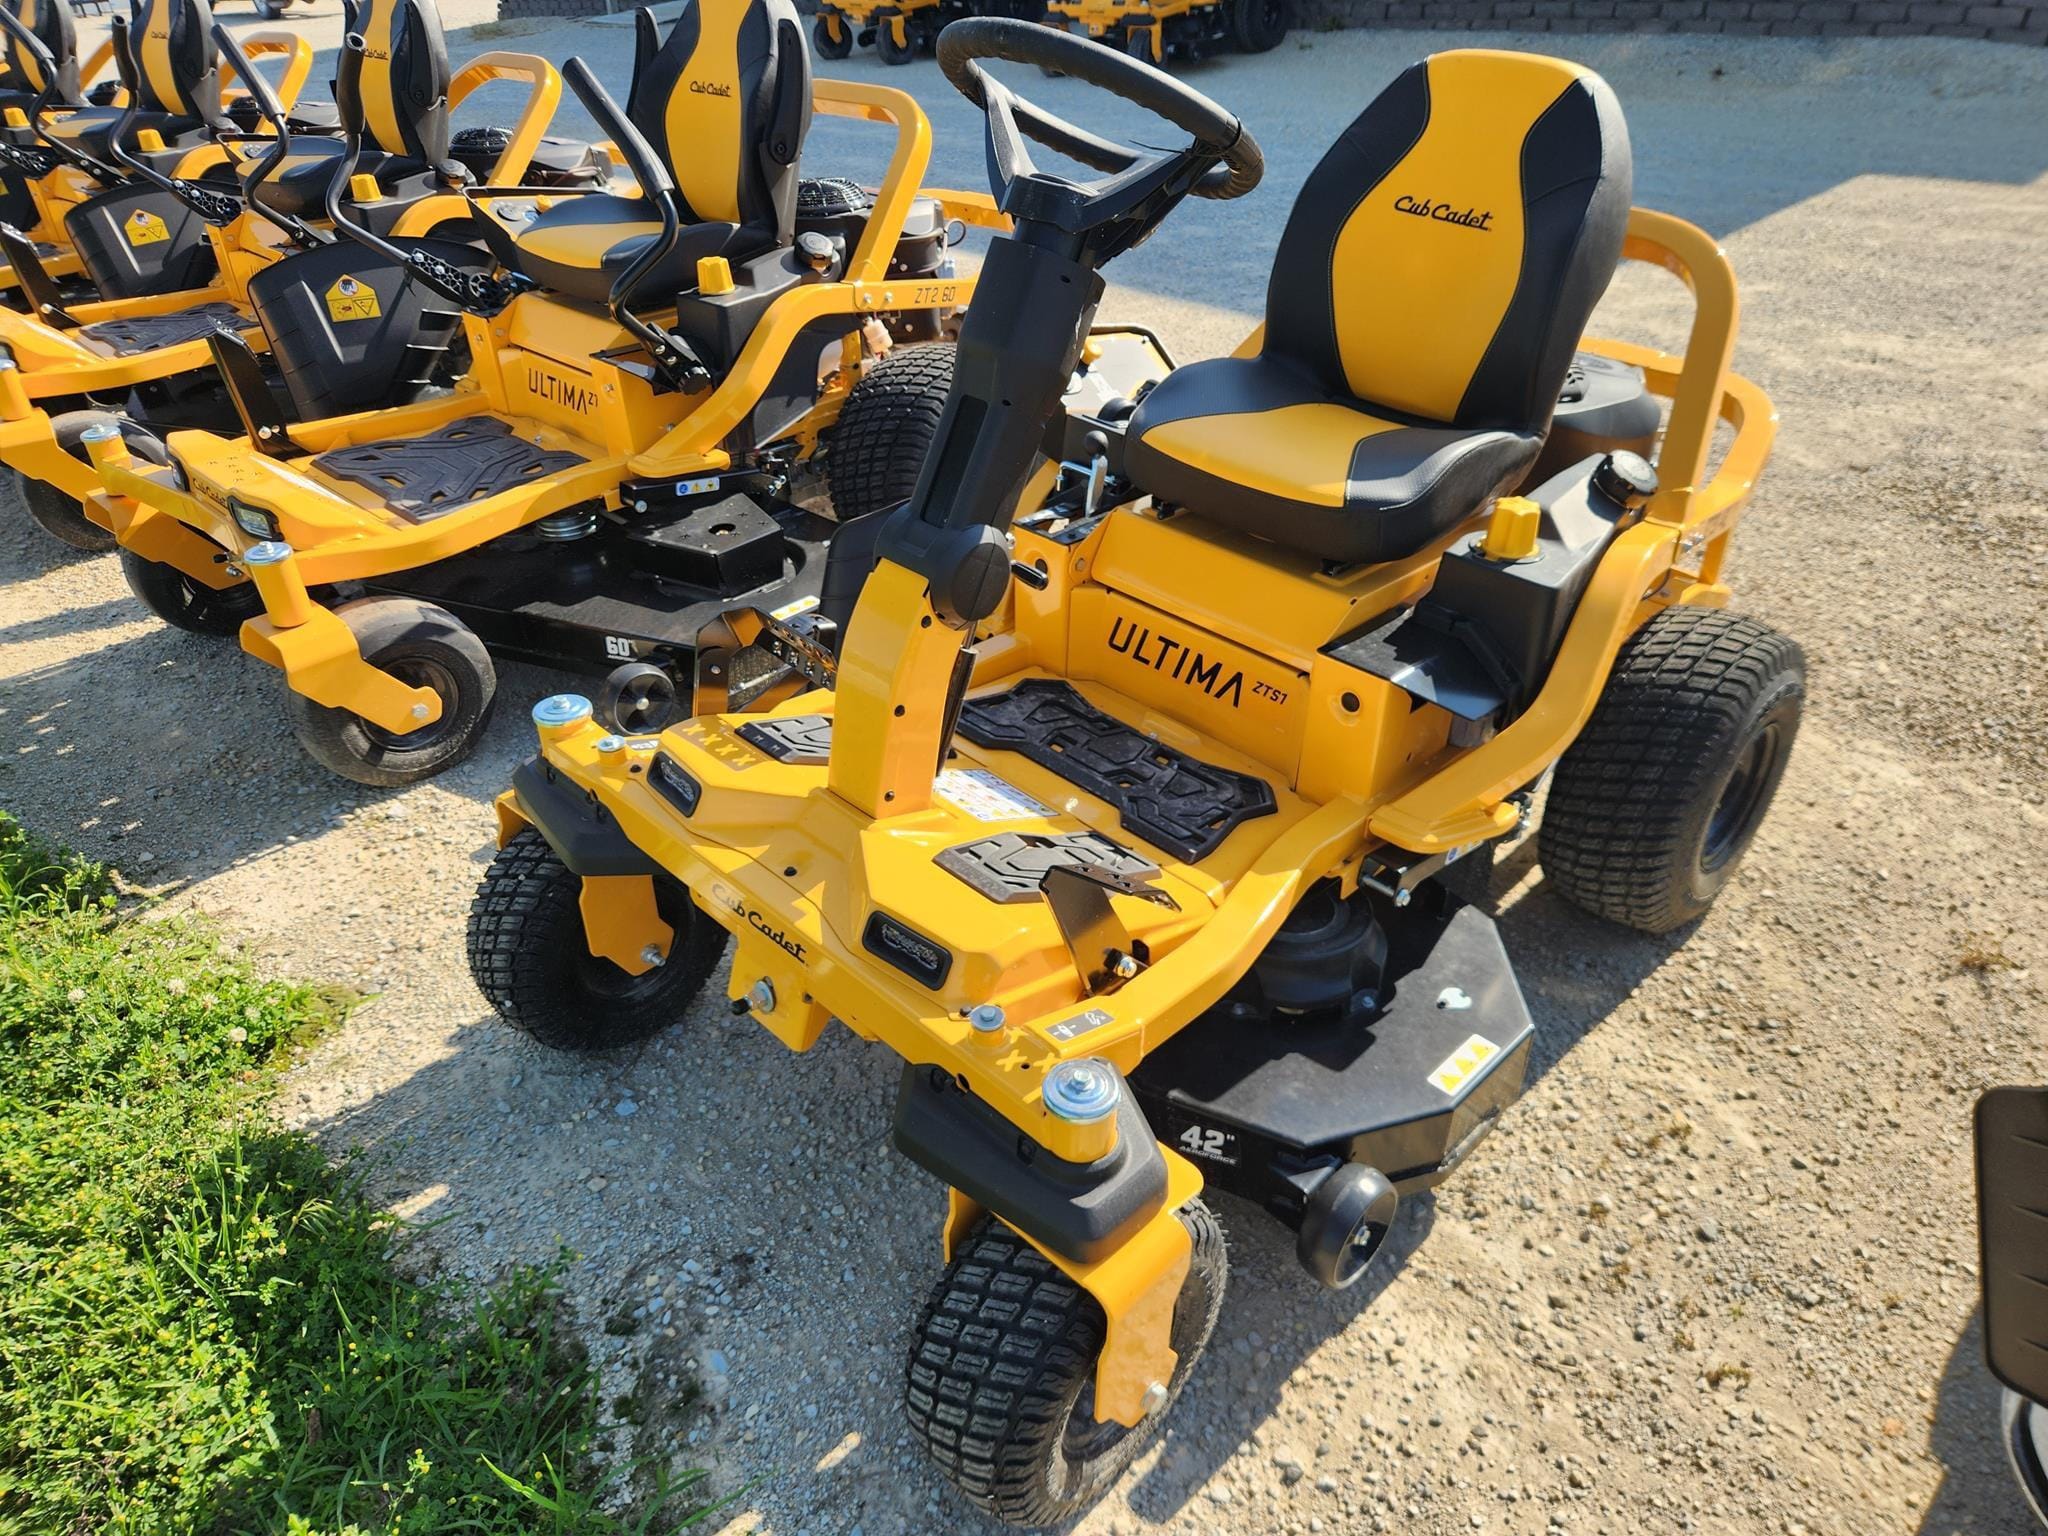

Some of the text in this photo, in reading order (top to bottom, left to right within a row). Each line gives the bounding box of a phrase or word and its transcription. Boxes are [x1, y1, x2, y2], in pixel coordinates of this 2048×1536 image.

[690, 81, 731, 98] Cub Cadet
[1394, 195, 1493, 232] Cub Cadet
[914, 286, 956, 304] ZT2 60
[528, 367, 588, 415] ULTIMA
[1107, 616, 1288, 708] ULTIMA ZTS1
[711, 883, 807, 965] Cub Cadet
[1180, 1125, 1236, 1155] 42"
